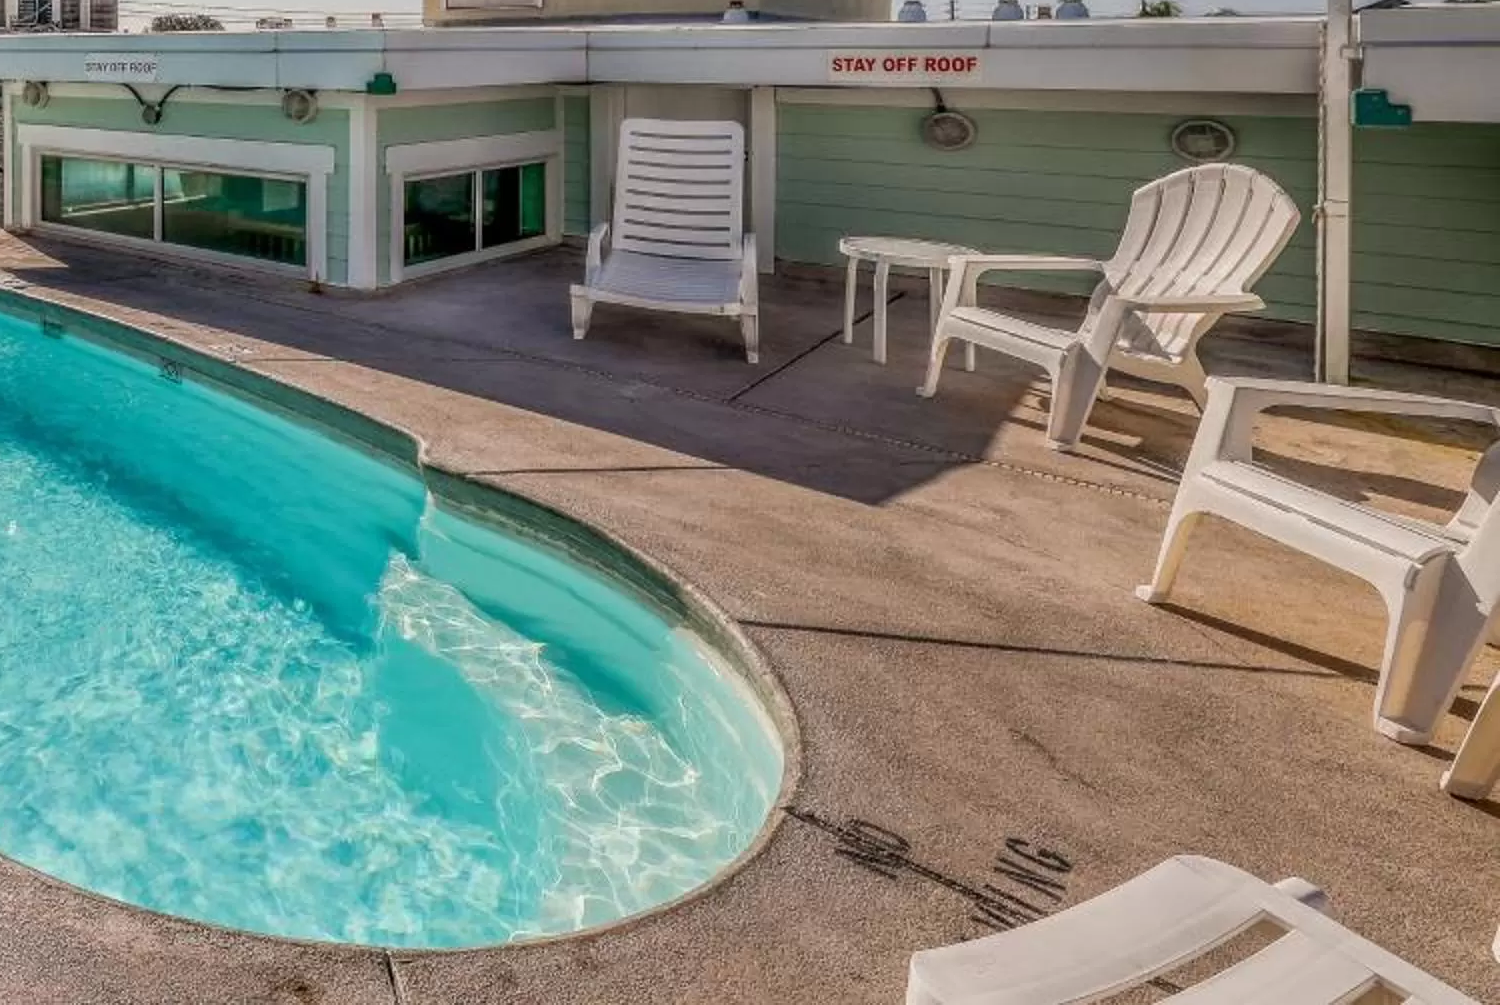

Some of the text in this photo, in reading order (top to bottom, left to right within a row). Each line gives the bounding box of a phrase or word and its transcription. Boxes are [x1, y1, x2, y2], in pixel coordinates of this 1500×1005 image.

[832, 57, 977, 72] STAY OFF ROOF
